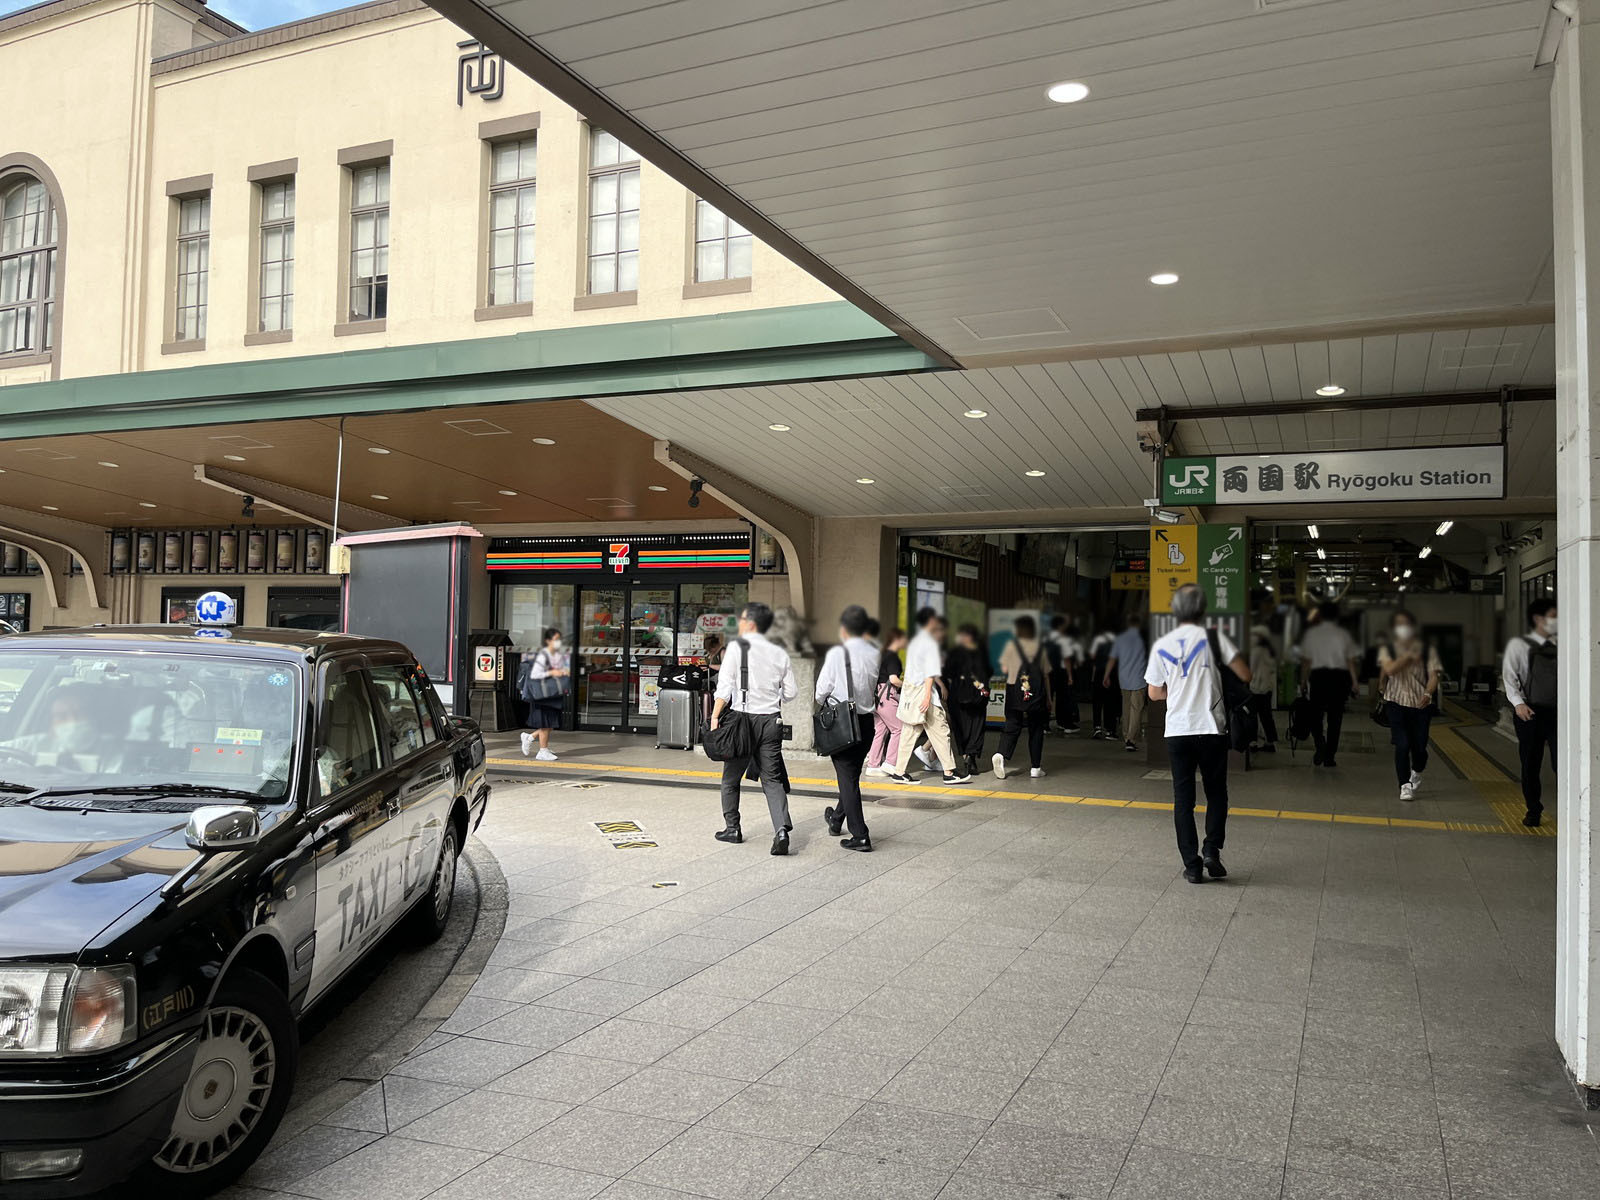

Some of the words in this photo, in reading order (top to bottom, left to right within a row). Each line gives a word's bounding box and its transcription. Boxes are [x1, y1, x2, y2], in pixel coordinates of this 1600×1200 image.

[1169, 465, 1210, 488] JR
[1327, 472, 1413, 491] Ryōgoku
[1420, 470, 1491, 486] Station
[703, 617, 723, 626] たばこ
[338, 856, 390, 952] TAXI
